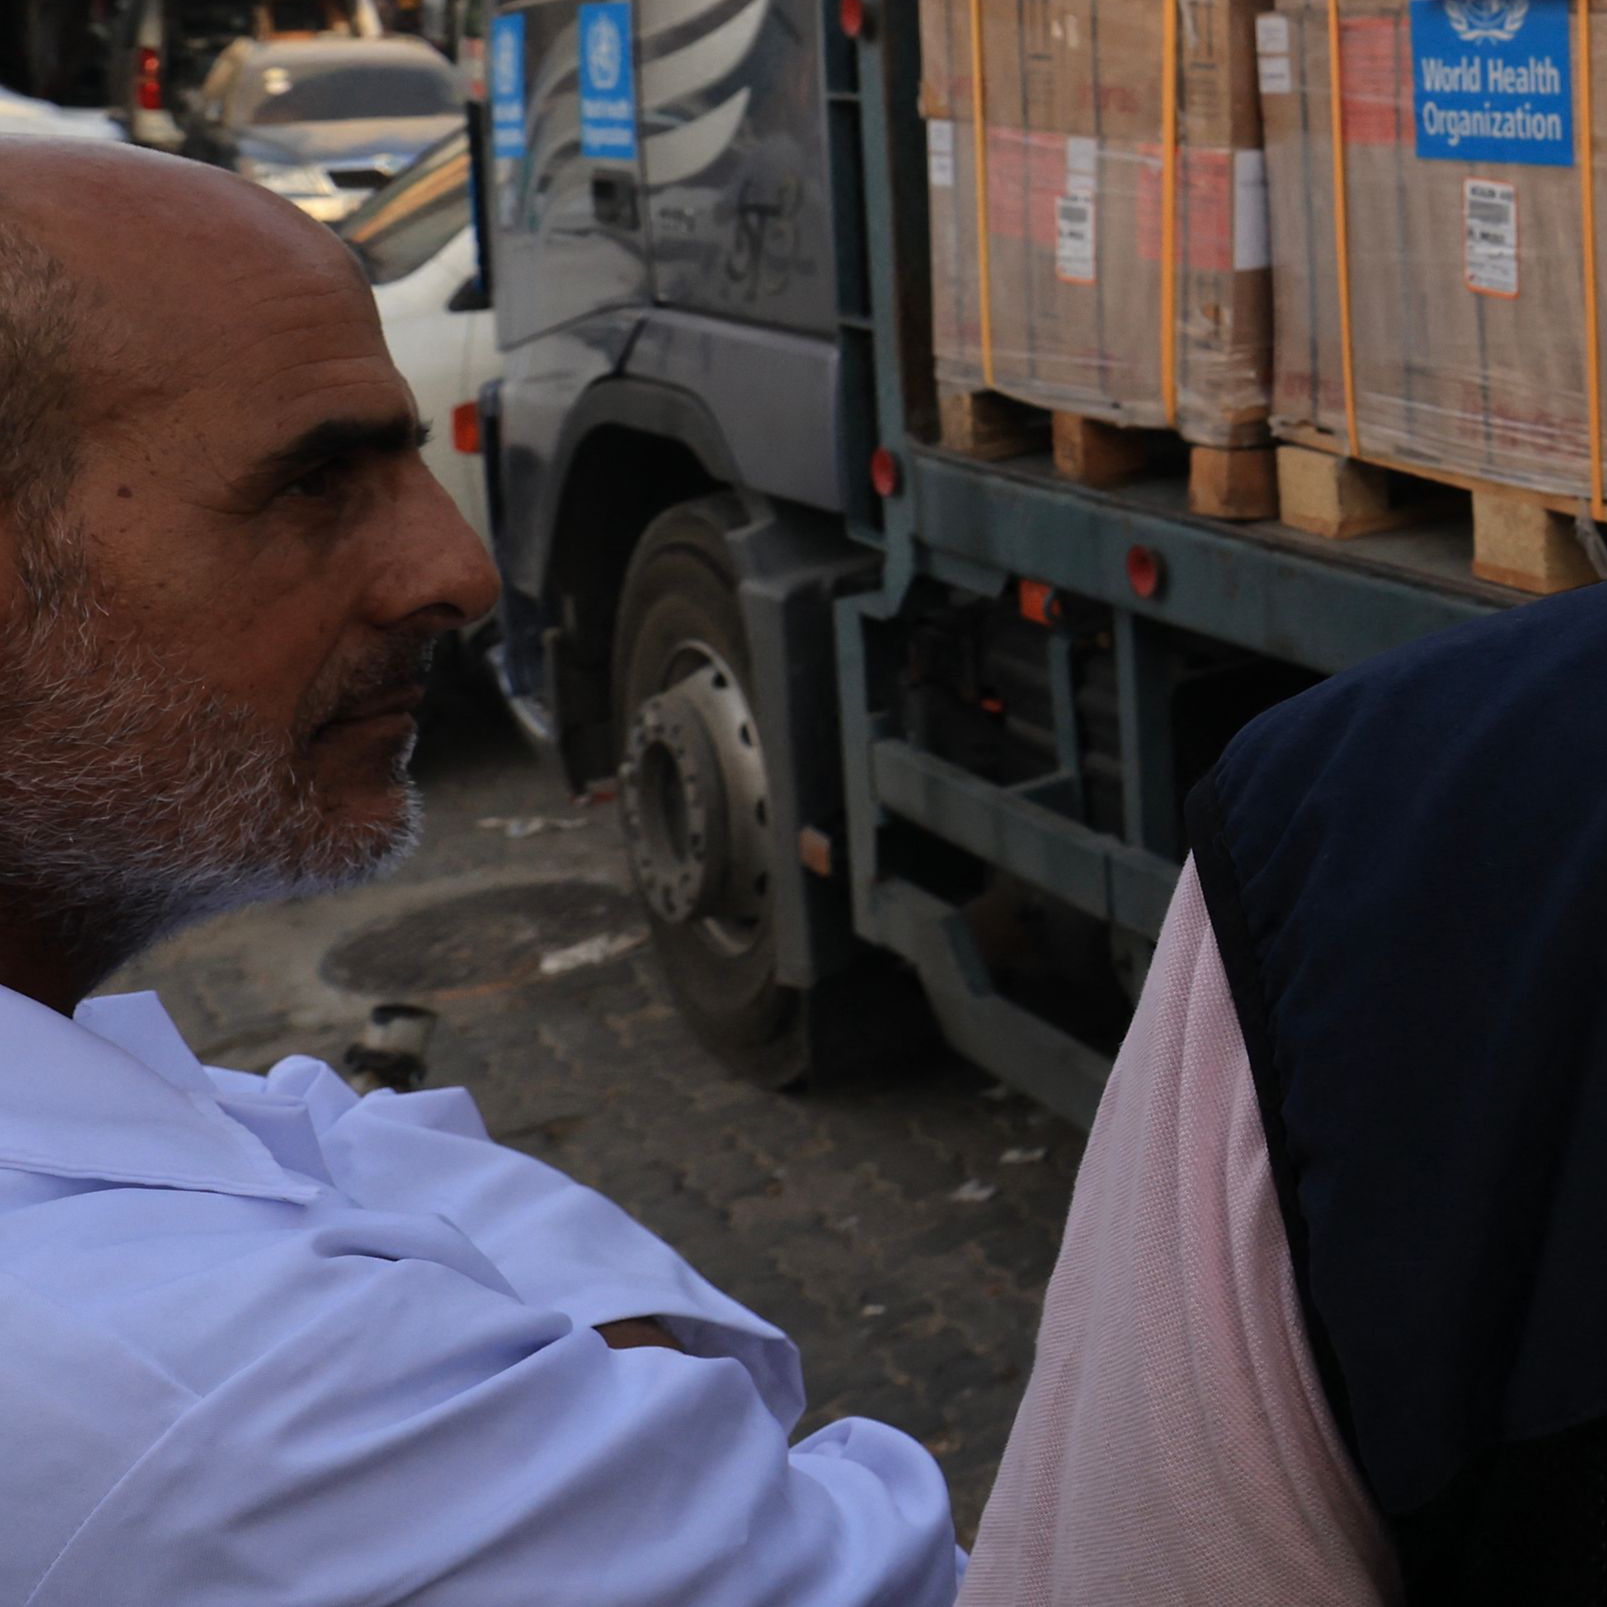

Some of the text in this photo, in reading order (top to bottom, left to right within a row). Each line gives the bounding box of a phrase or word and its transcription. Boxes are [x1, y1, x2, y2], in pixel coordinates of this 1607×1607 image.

[1421, 56, 1561, 95] World Health
[1422, 101, 1563, 146] Organization
